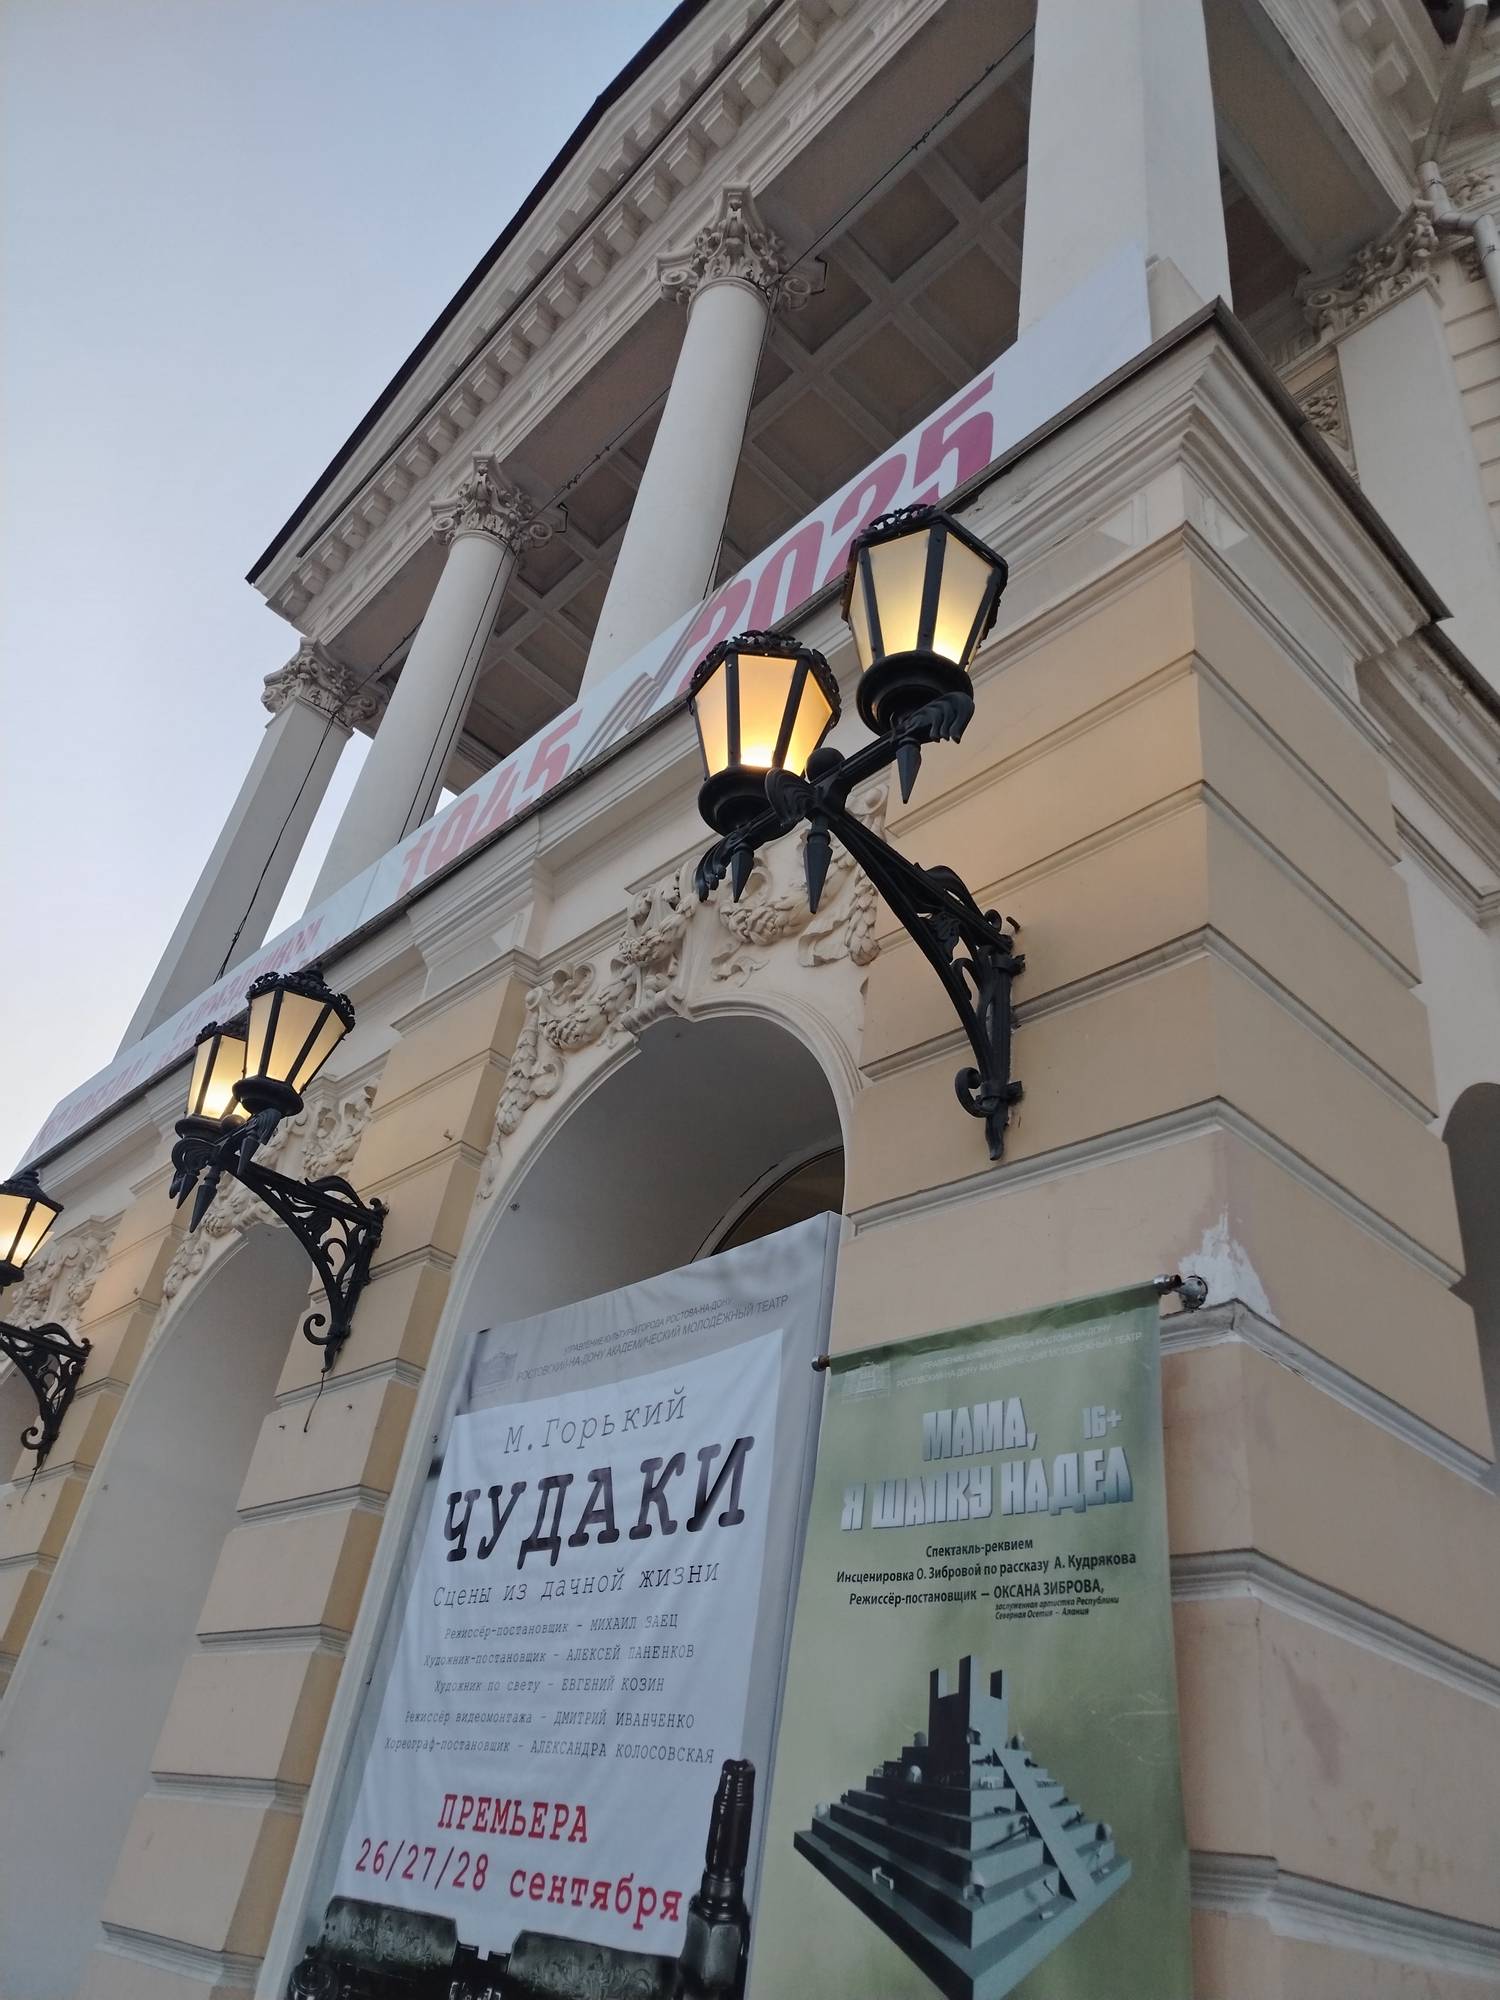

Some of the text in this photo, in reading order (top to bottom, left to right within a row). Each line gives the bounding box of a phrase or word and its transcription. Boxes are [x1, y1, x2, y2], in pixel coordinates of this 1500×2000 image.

[606, 1325, 681, 1358] АКАДЕМИЧЕСКИЙ
[756, 1294, 790, 1314] ТЕАТР
[922, 1396, 1038, 1461] МАМА,
[1082, 1405, 1122, 1440] 16+
[444, 1435, 755, 1570] ЧУДАКИ
[841, 1446, 1135, 1531] Я ШАПКУ НАДЕЛ
[926, 1538, 1034, 1559] Спектакль-реквием
[836, 1569, 914, 1585] Инсценировка
[929, 1563, 982, 1582] Зибровой
[984, 1564, 998, 1576] по
[999, 1560, 1049, 1577] рассказу
[1054, 1555, 1065, 1569] А.
[1068, 1552, 1137, 1571] Кудрякова
[433, 1562, 721, 1608] Сцены из дачной жизни
[849, 1589, 977, 1608] Режиссёр-постановщик
[993, 1582, 1041, 1600] ОКСАНА
[1043, 1578, 1105, 1597] ЗИБРОВА,
[995, 1610, 1027, 1621] Северная
[1062, 1607, 1090, 1617] Алания
[1076, 1596, 1120, 1608] Республики
[444, 1622, 569, 1641] Режиссёр-постановщик
[590, 1616, 637, 1631] МИХАИЛ
[644, 1614, 679, 1629] ЗАЕЦ
[424, 1651, 547, 1669] Художник-постановщик
[566, 1644, 621, 1662] АЛЕКСЕЙ
[627, 1644, 695, 1660] ПАНЕНКОВ
[434, 1679, 483, 1695] Художник
[487, 1681, 500, 1692] по
[507, 1680, 541, 1694] свету
[561, 1675, 615, 1692] ЕВГЕНИЙ
[621, 1677, 665, 1692] КОЗИН
[405, 1710, 451, 1726] Режиссёр
[455, 1711, 533, 1725] видеомонтажа
[553, 1708, 607, 1727] ДМИТРИЙ
[615, 1711, 695, 1729] ИВАНЧЕНКО
[384, 1736, 511, 1753] Хореограф-постановщик
[530, 1739, 607, 1758] АЛЕКСАНДРА
[615, 1743, 715, 1764] КОЛОСОВСКАЯ
[438, 1793, 588, 1844] ПРЕМЬЕРА
[355, 1837, 684, 1931] 26/27/28 сентября
